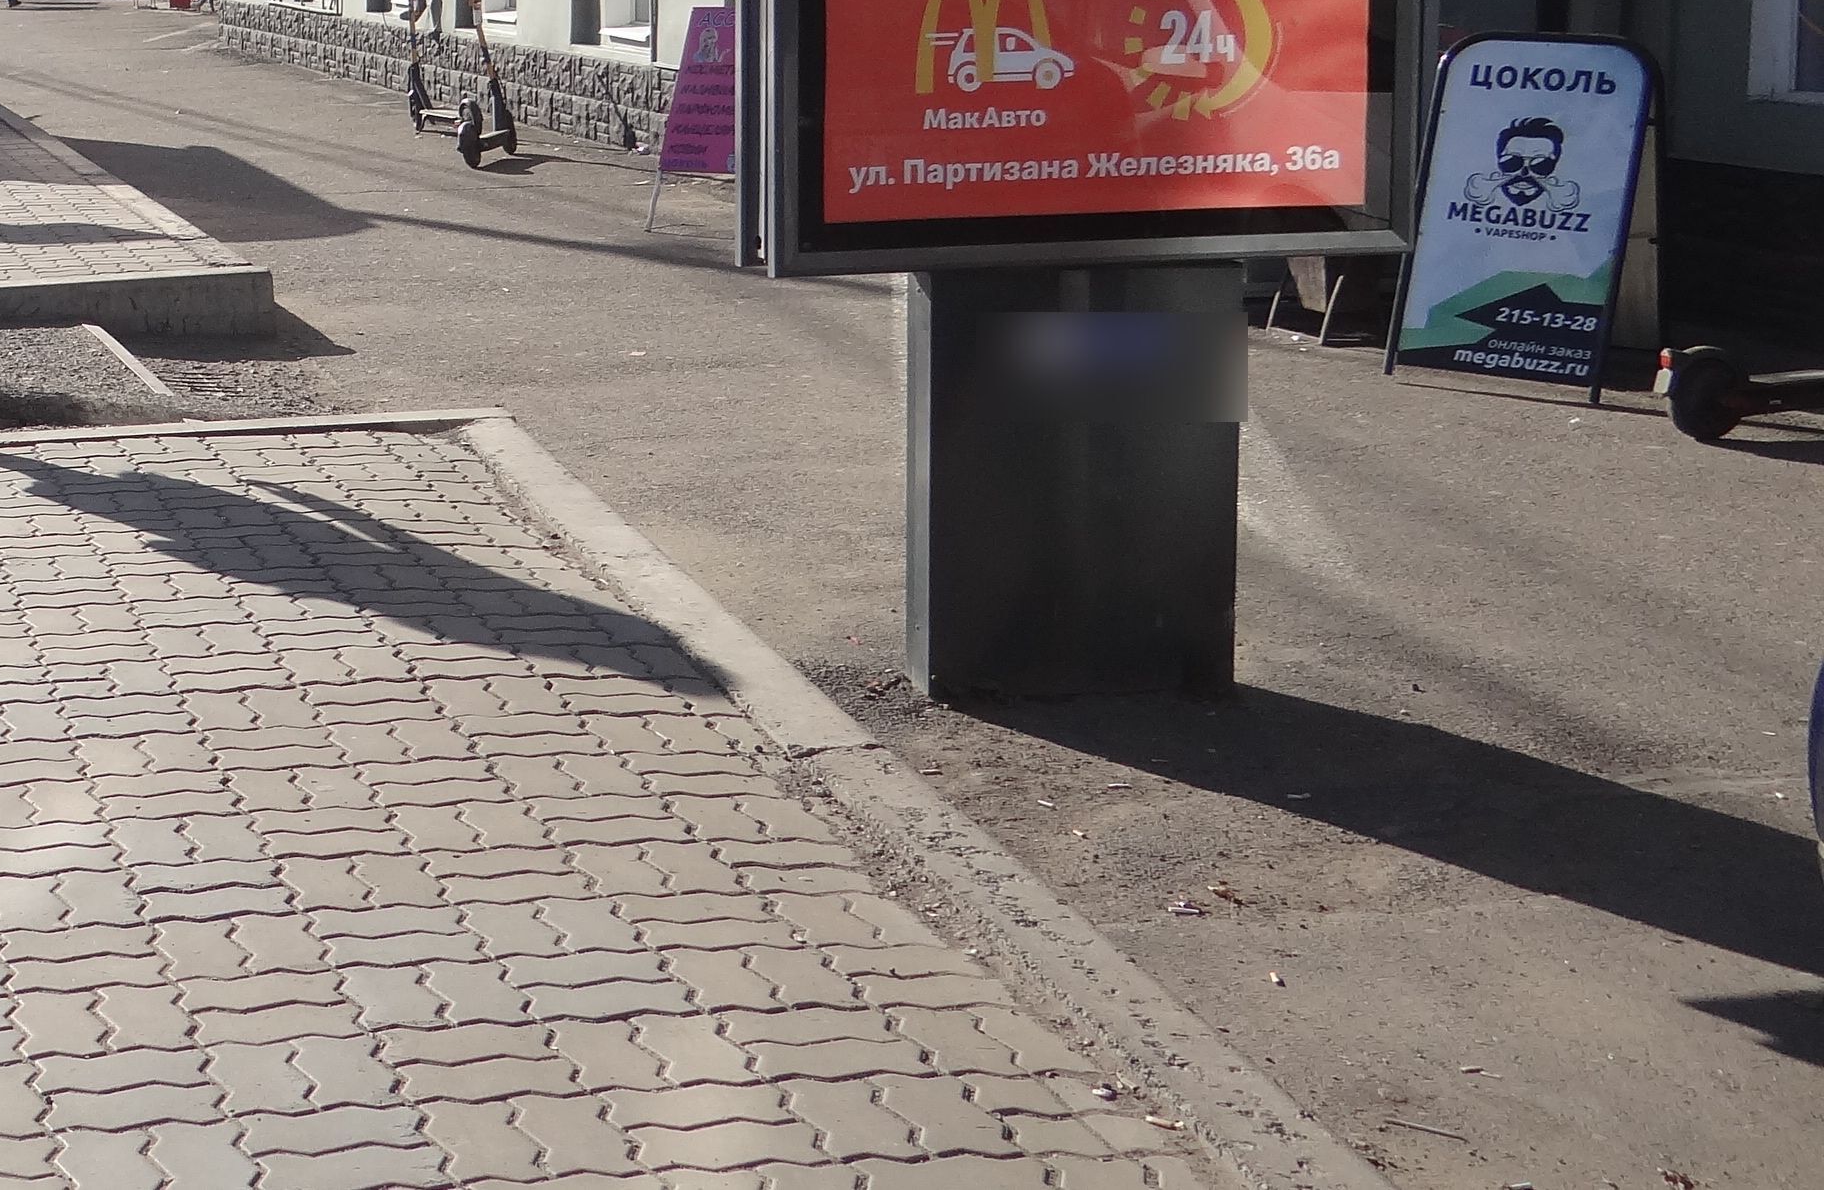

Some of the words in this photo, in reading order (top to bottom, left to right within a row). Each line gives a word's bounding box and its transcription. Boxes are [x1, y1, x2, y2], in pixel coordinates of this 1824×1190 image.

[1469, 64, 1617, 95] ЦОКОЛЬ
[923, 107, 1046, 130] МакАвто
[848, 166, 896, 194] ул.
[903, 158, 1079, 190] Партизана
[1085, 151, 1280, 178] Железняка,
[1285, 145, 1339, 171] 36а
[1447, 201, 1592, 233] MEGABUZZ
[1485, 227, 1547, 242] VAPESHOP
[1496, 307, 1598, 332] 215-13-28
[1488, 339, 1546, 354] онлайн
[1549, 346, 1593, 360] заказ
[1453, 349, 1590, 377] megabuzz.ru
